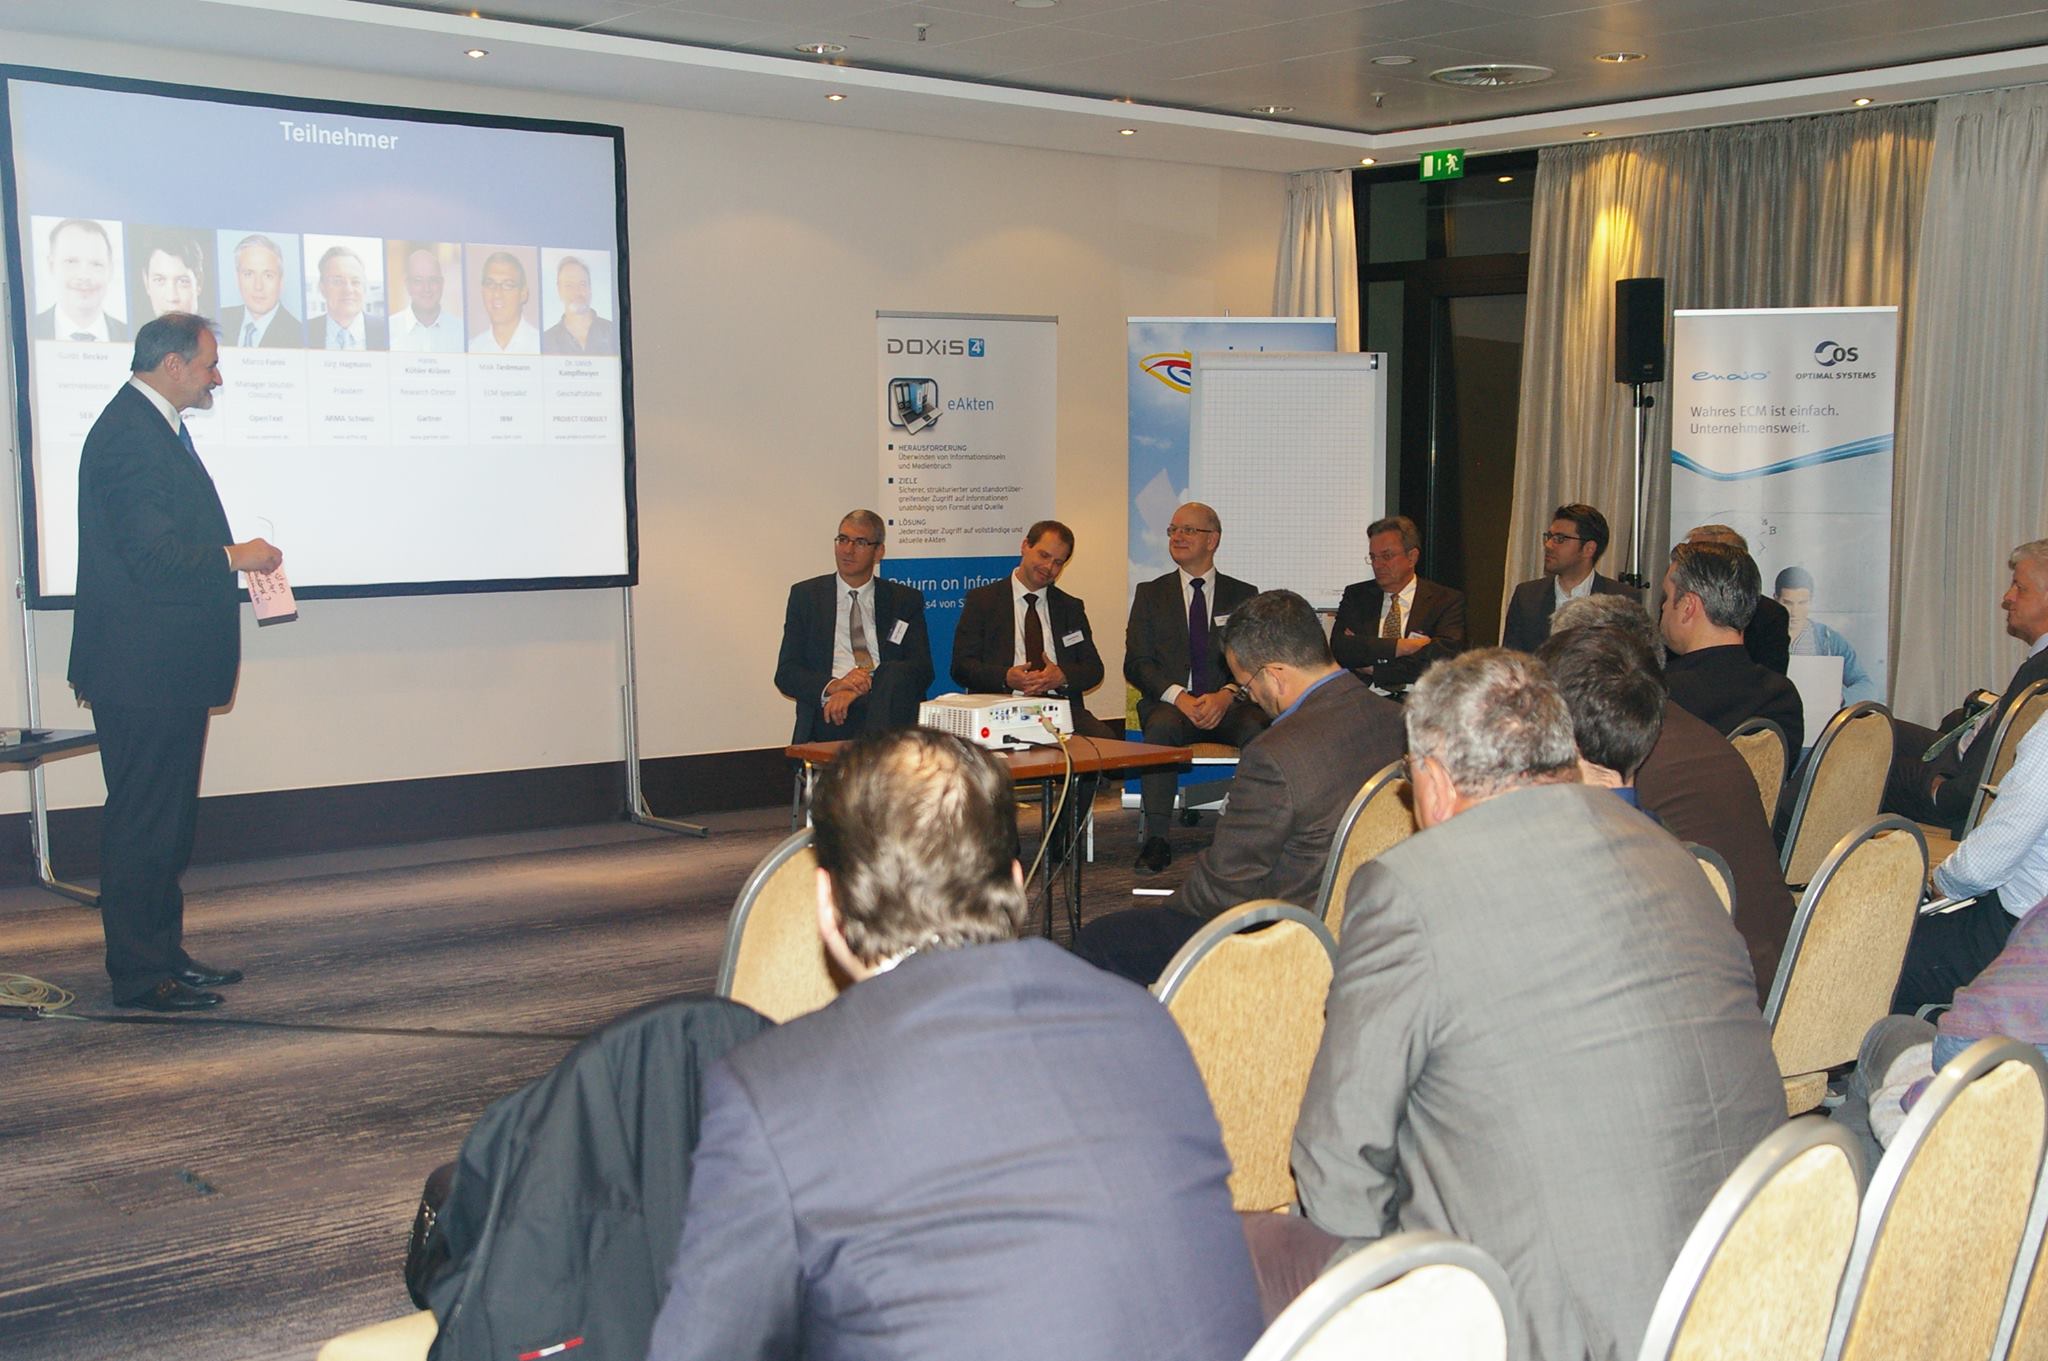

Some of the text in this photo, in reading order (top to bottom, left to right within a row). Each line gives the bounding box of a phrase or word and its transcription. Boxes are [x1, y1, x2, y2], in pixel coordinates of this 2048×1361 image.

[280, 121, 398, 149] Teilnehmer
[1796, 371, 1876, 380] OPTIMAL SYSTEMS
[947, 397, 994, 411] eAkten
[1690, 404, 1839, 417] Wahres ECM ist einfach.
[1690, 422, 1810, 434] Unternehmensweit.
[898, 444, 967, 452] HERAUSFORDERUNG
[898, 477, 918, 485] ZIELE
[984, 503, 1004, 511] Quelle
[898, 518, 926, 526] LÖSUNG
[940, 527, 962, 535] Zugriff
[940, 578, 960, 591] on
[939, 600, 957, 609] von
